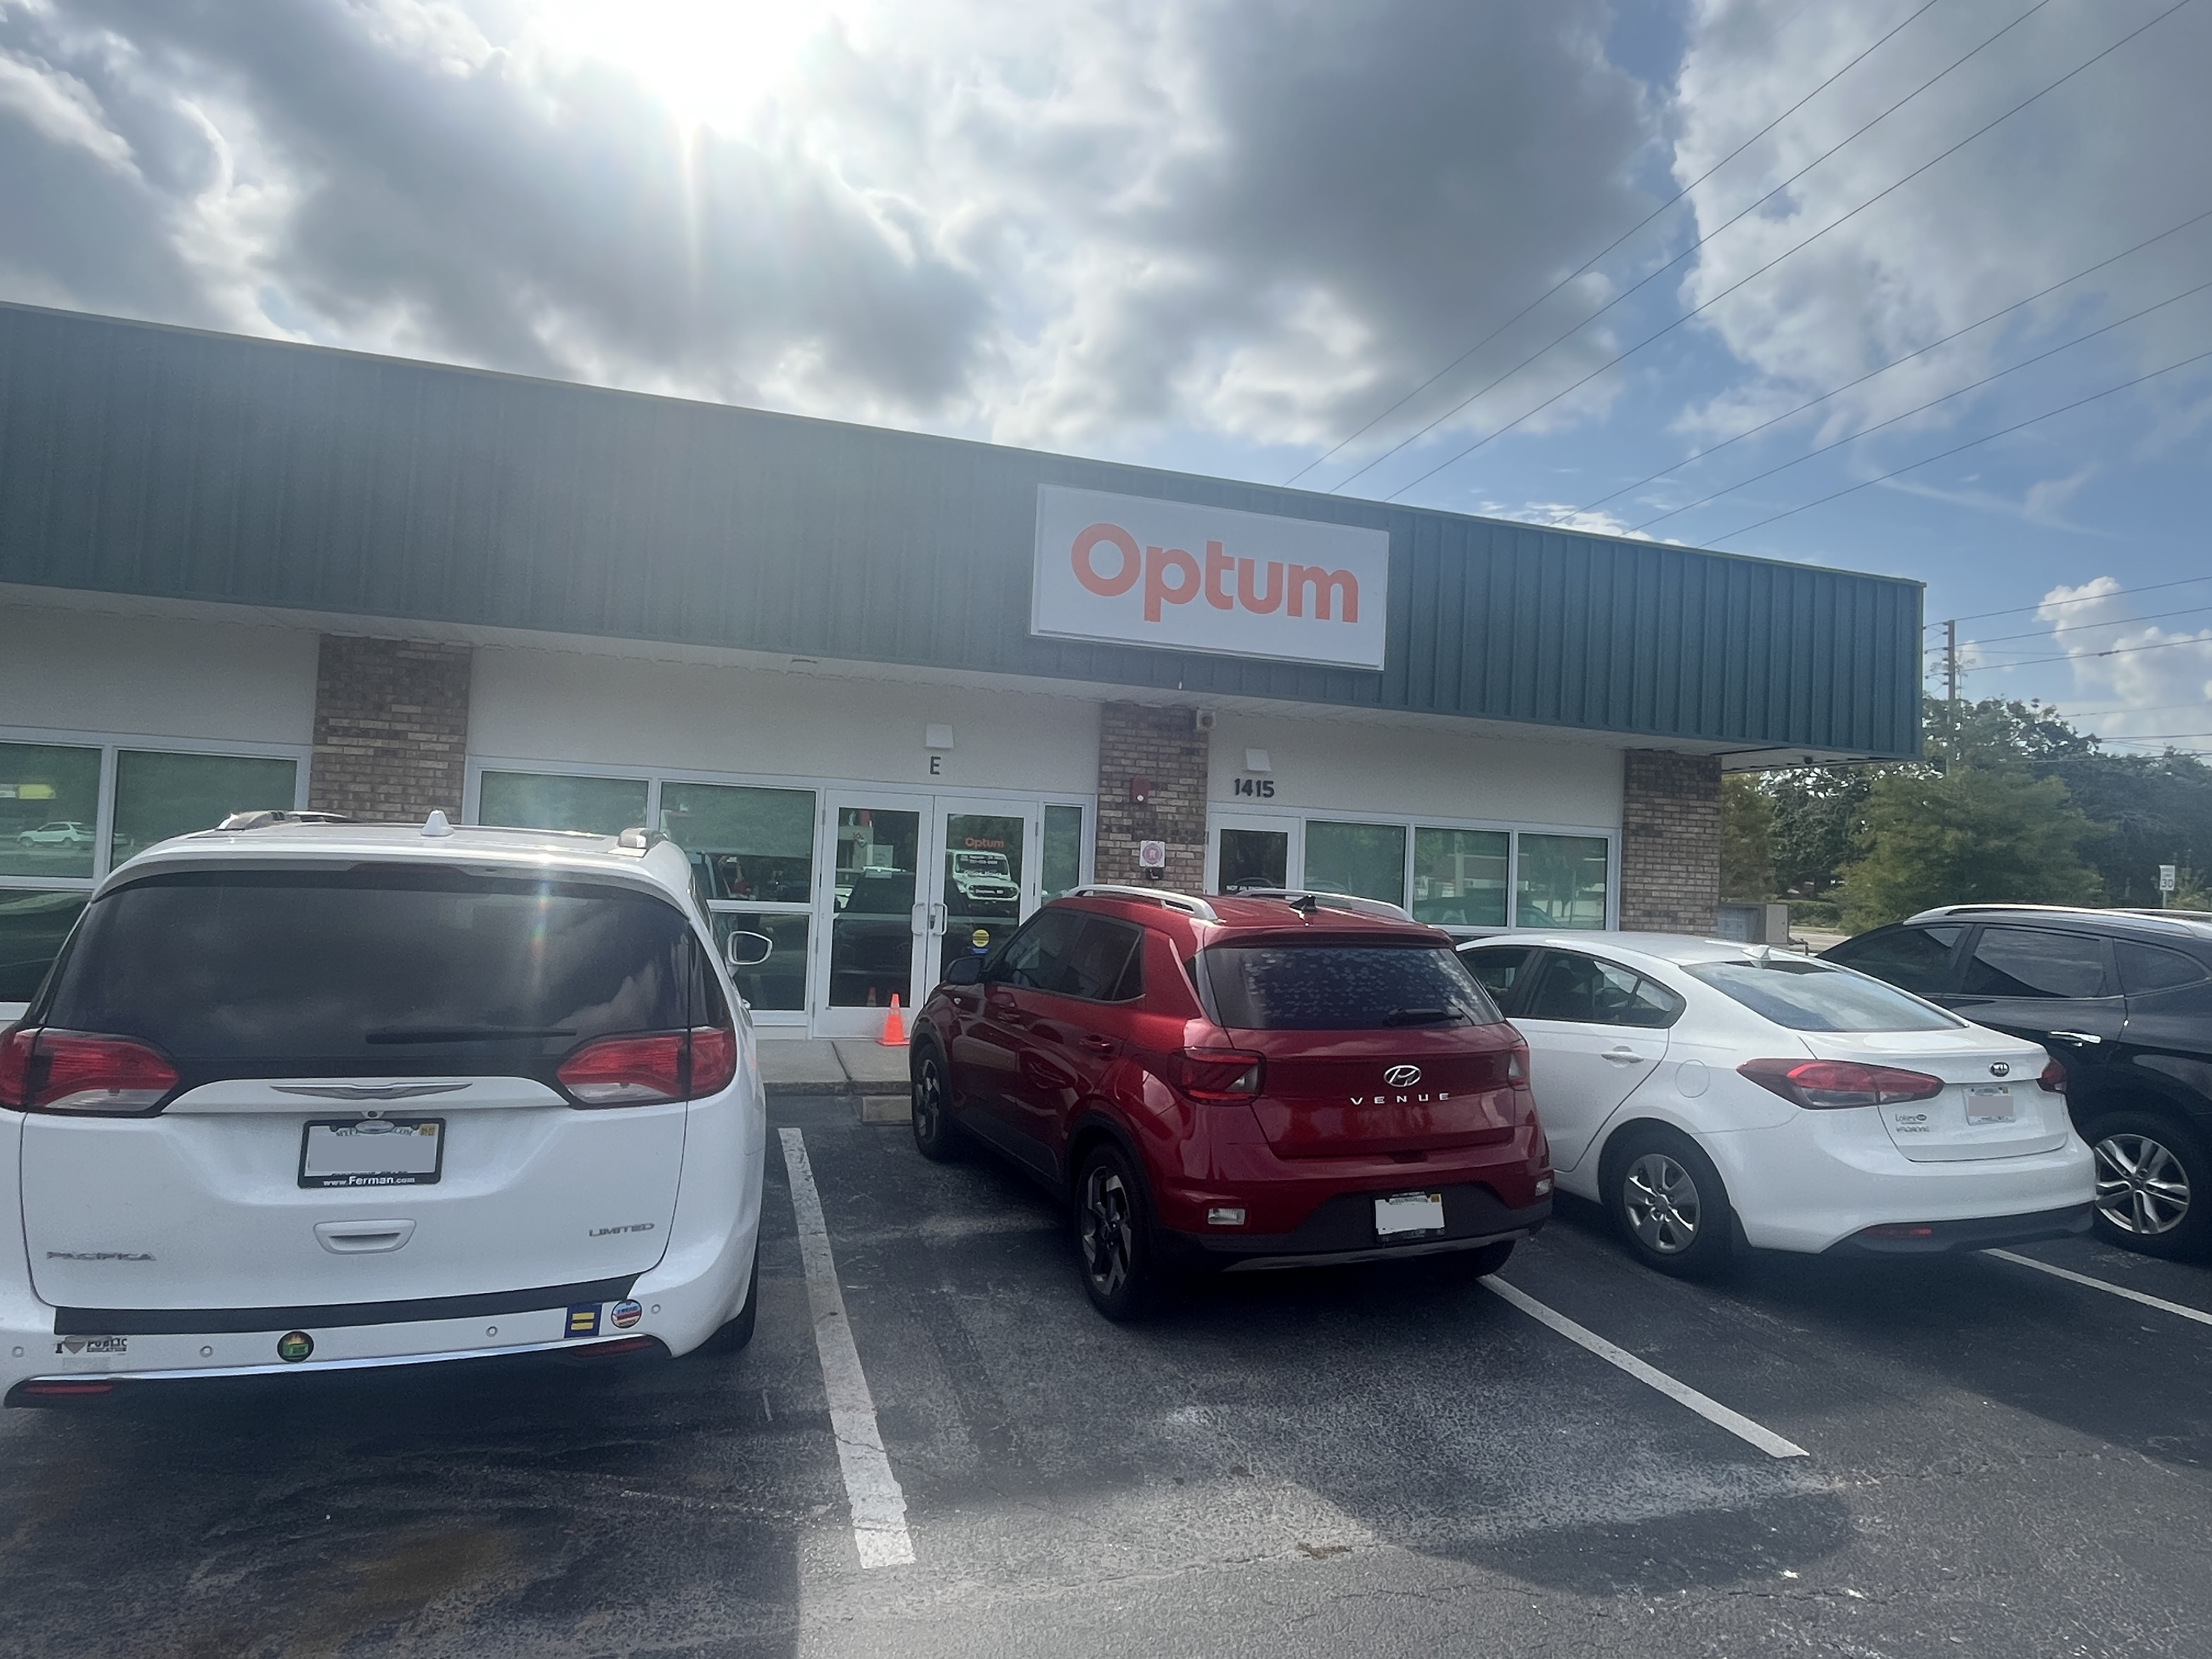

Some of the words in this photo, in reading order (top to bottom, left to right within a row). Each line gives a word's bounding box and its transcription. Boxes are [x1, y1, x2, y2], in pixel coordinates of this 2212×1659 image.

[1071, 522, 1358, 623] Optum
[930, 756, 941, 775] E
[1234, 778, 1274, 798] 1415
[965, 837, 1005, 849] Optum
[2162, 879, 2173, 888] 30
[1350, 1093, 1449, 1105] VENUE
[323, 1176, 416, 1186] www.Ferman.com
[589, 1222, 655, 1237] LIMITED
[46, 1251, 157, 1261] PACIFICA
